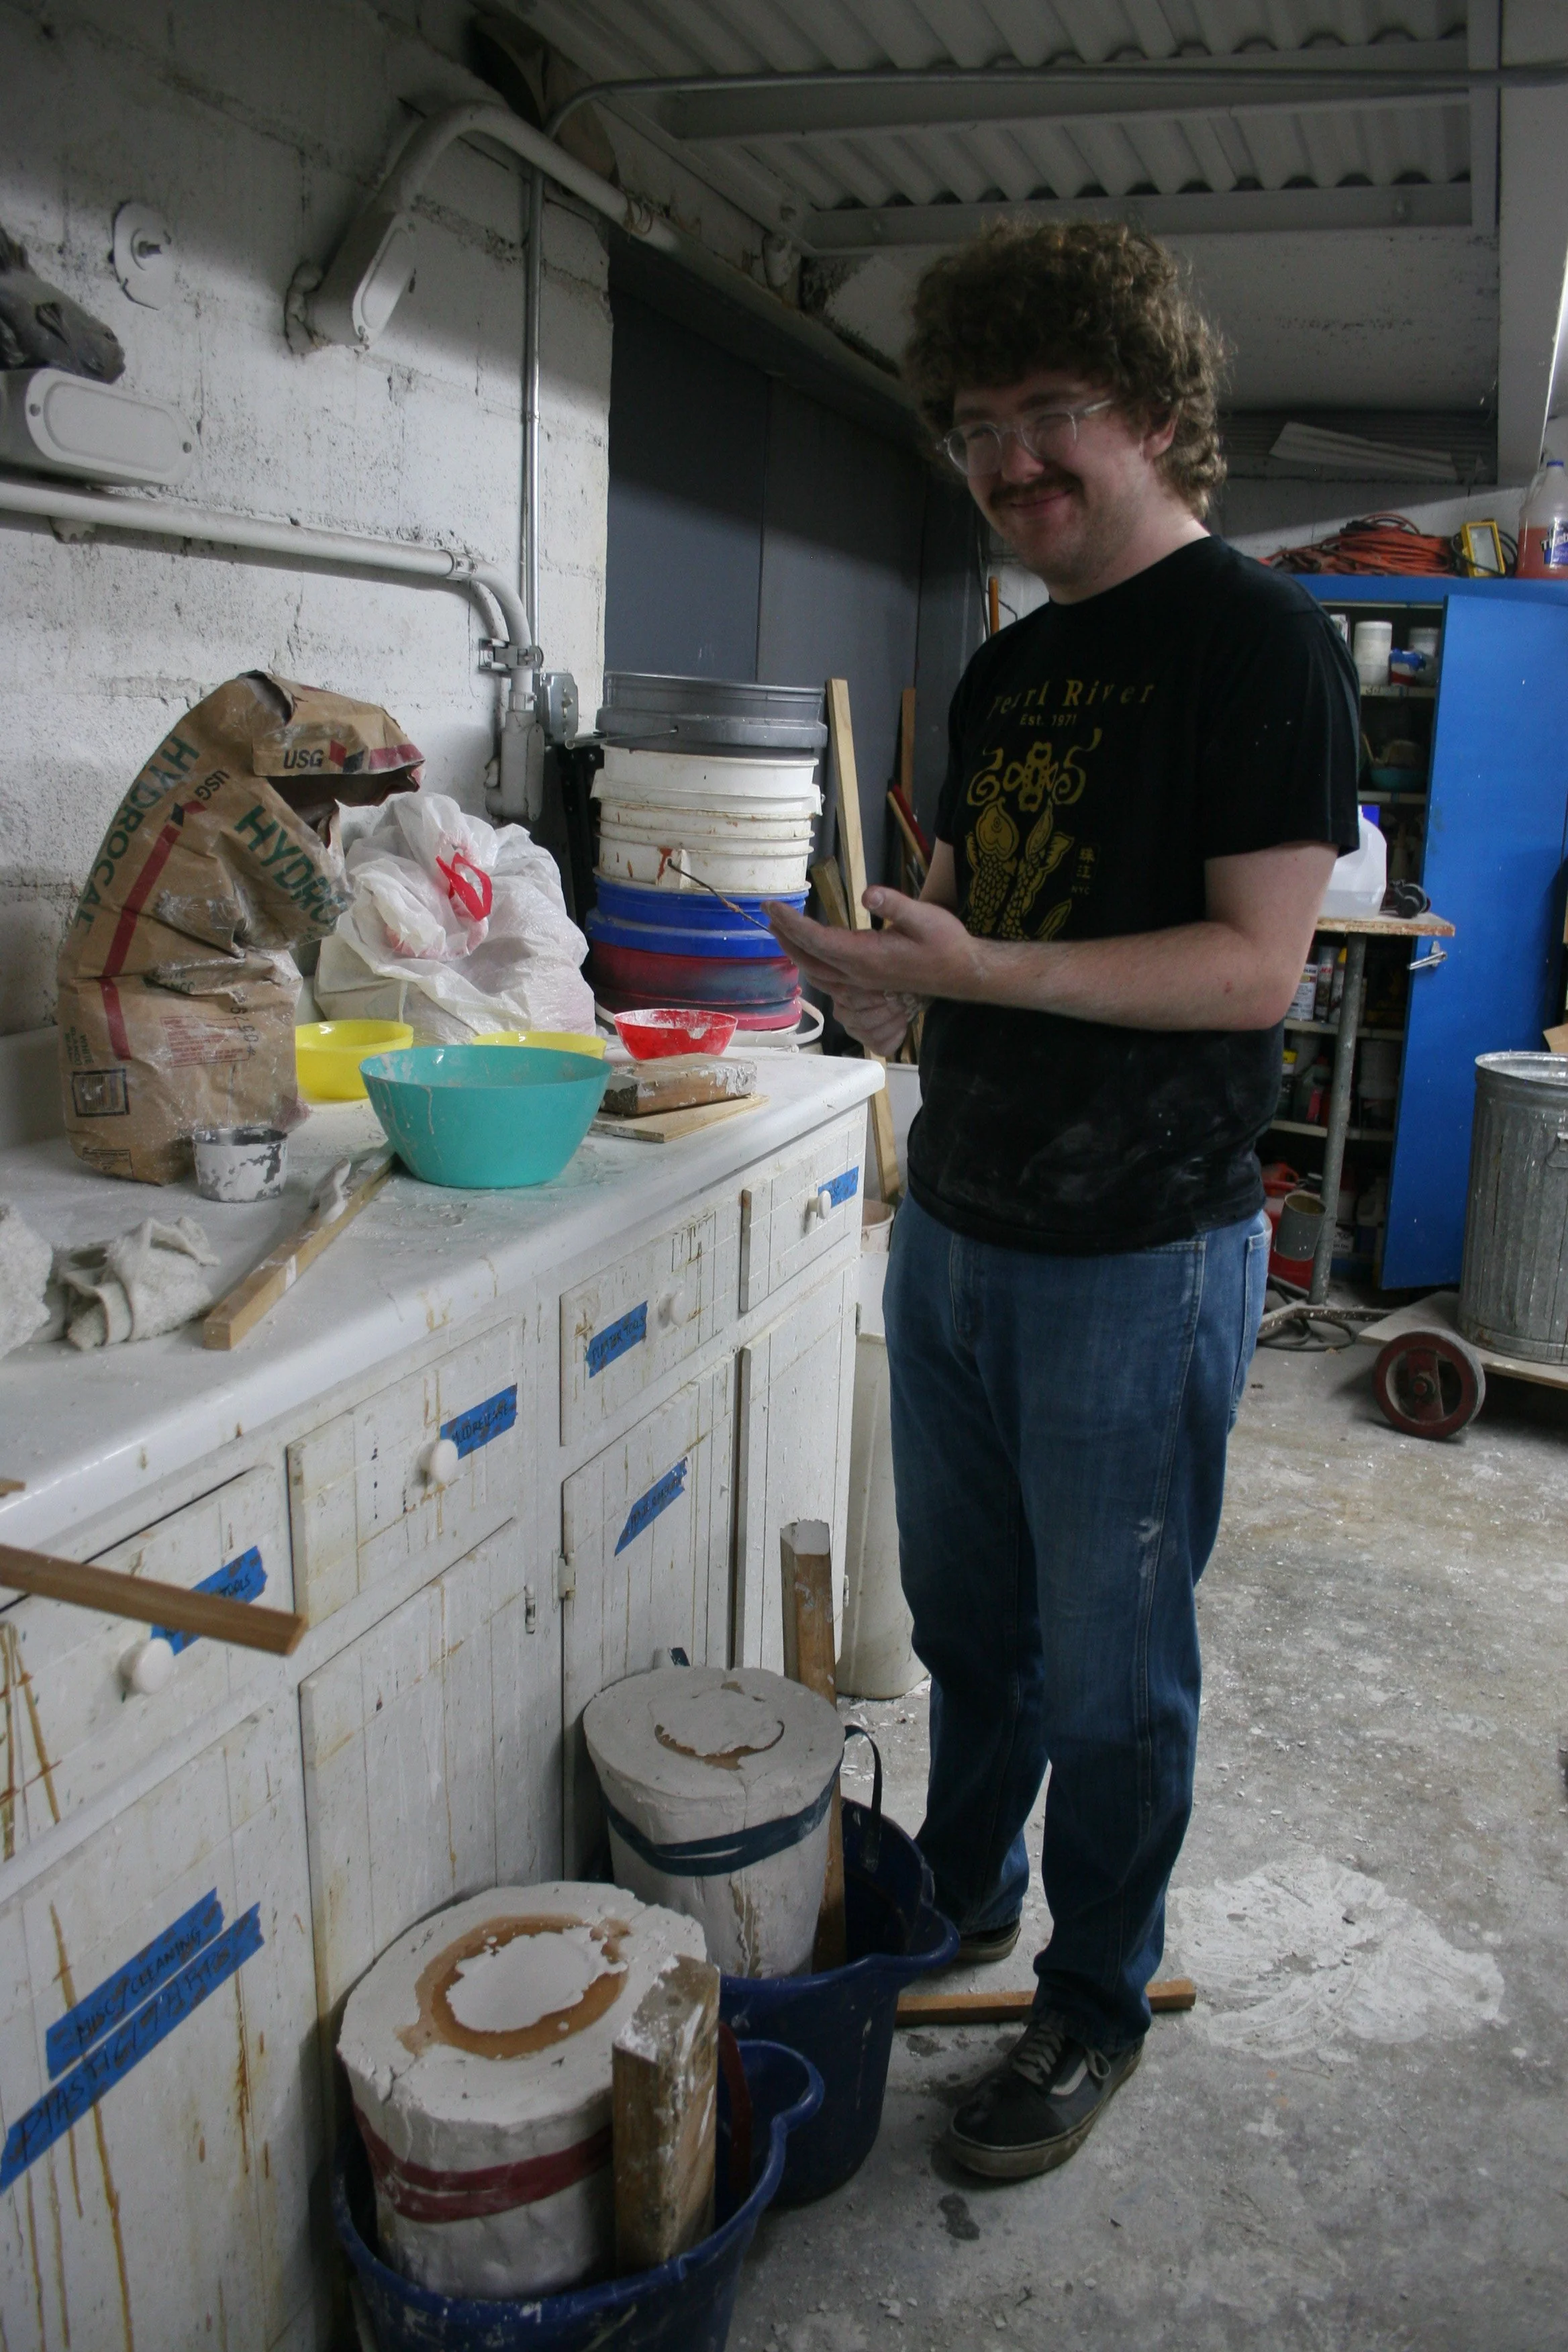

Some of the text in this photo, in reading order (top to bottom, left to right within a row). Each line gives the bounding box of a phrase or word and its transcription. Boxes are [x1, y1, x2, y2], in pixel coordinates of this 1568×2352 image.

[1062, 679, 1155, 707] River
[1019, 714, 1078, 726] Est. 1971
[283, 749, 324, 769] USG
[195, 770, 230, 801] USG
[75, 736, 201, 936] HYDROCAL
[1071, 885, 1091, 895] NYC
[221, 1573, 251, 1598] TOOLS
